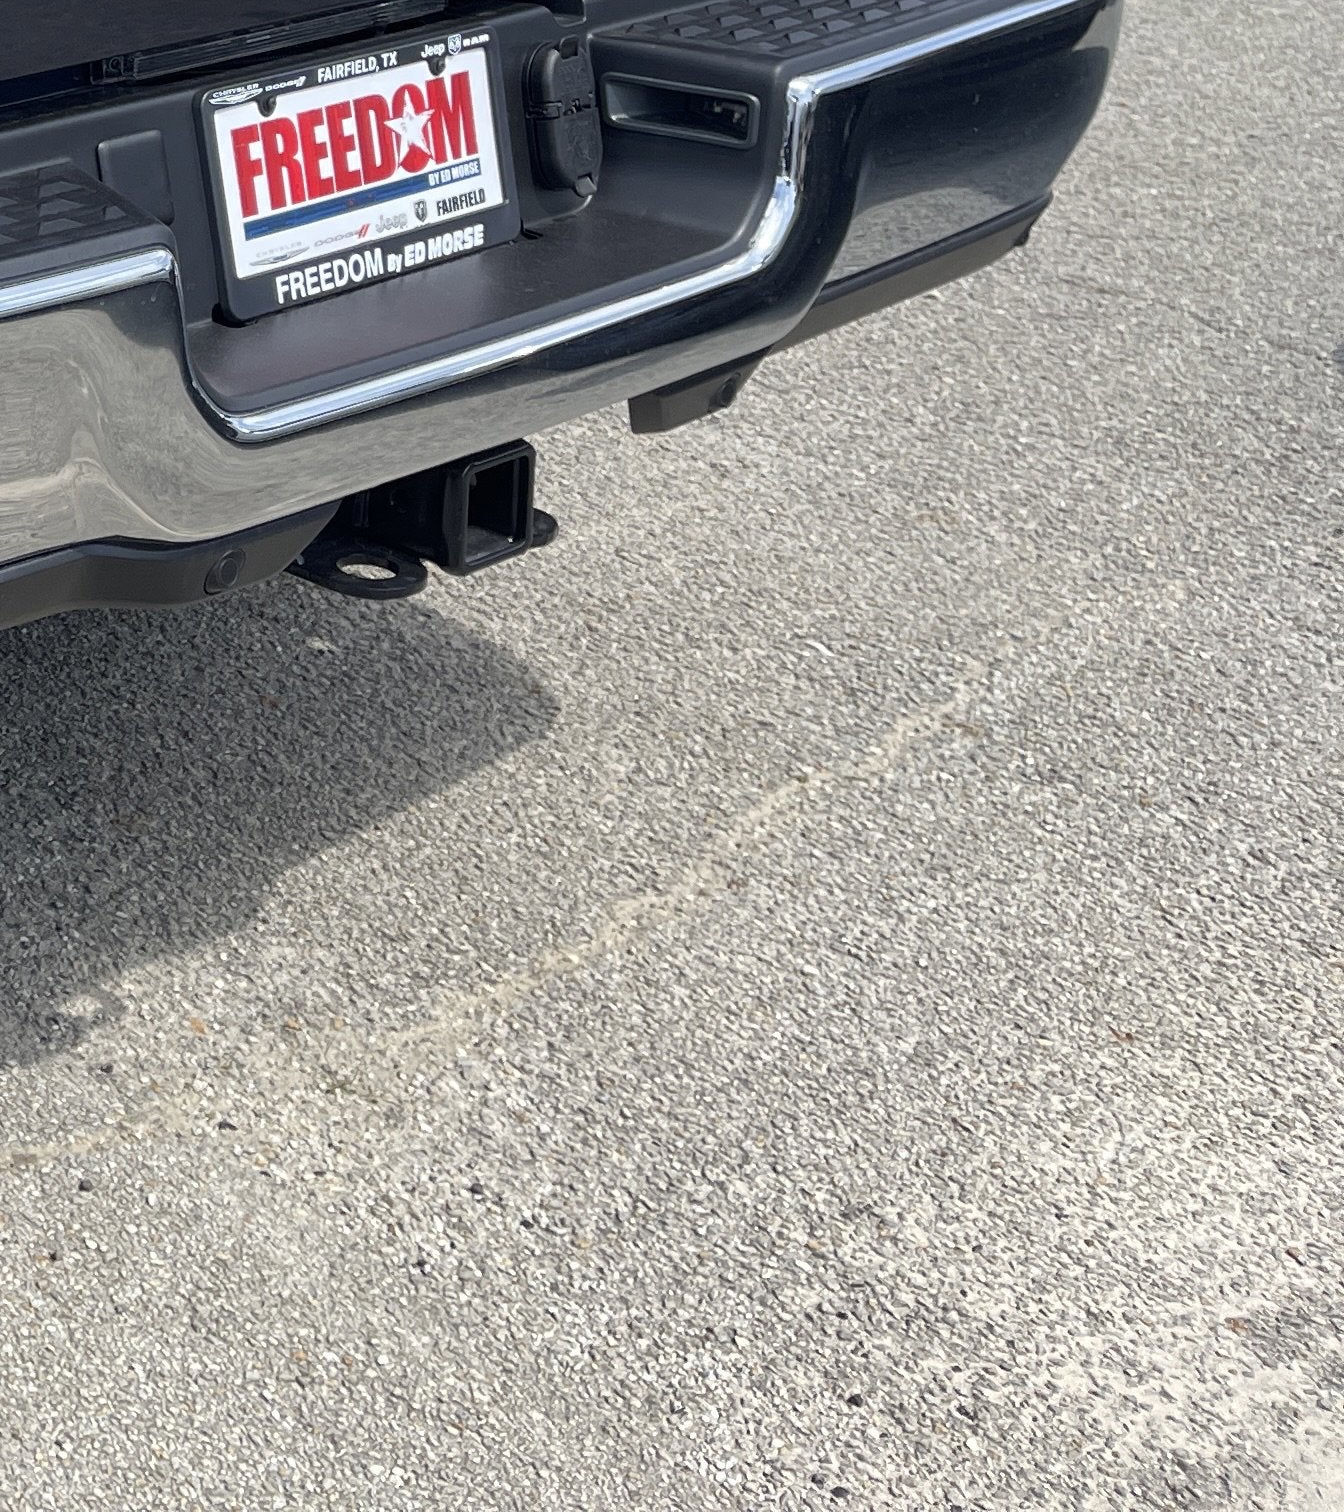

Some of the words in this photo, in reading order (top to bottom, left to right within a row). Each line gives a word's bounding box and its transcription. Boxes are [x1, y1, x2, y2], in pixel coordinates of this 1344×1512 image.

[317, 56, 379, 84] FAIRFIELD,
[381, 50, 398, 69] TX
[420, 43, 445, 58] Jeep
[230, 70, 479, 218] FREEDOM
[440, 169, 451, 183] ED
[452, 161, 480, 180] MORSE
[436, 188, 486, 216] FAIRFIELD
[375, 213, 409, 233] Jeep
[275, 247, 384, 304] FREEDOM
[404, 242, 426, 267] ED
[428, 224, 484, 260] MORSE
